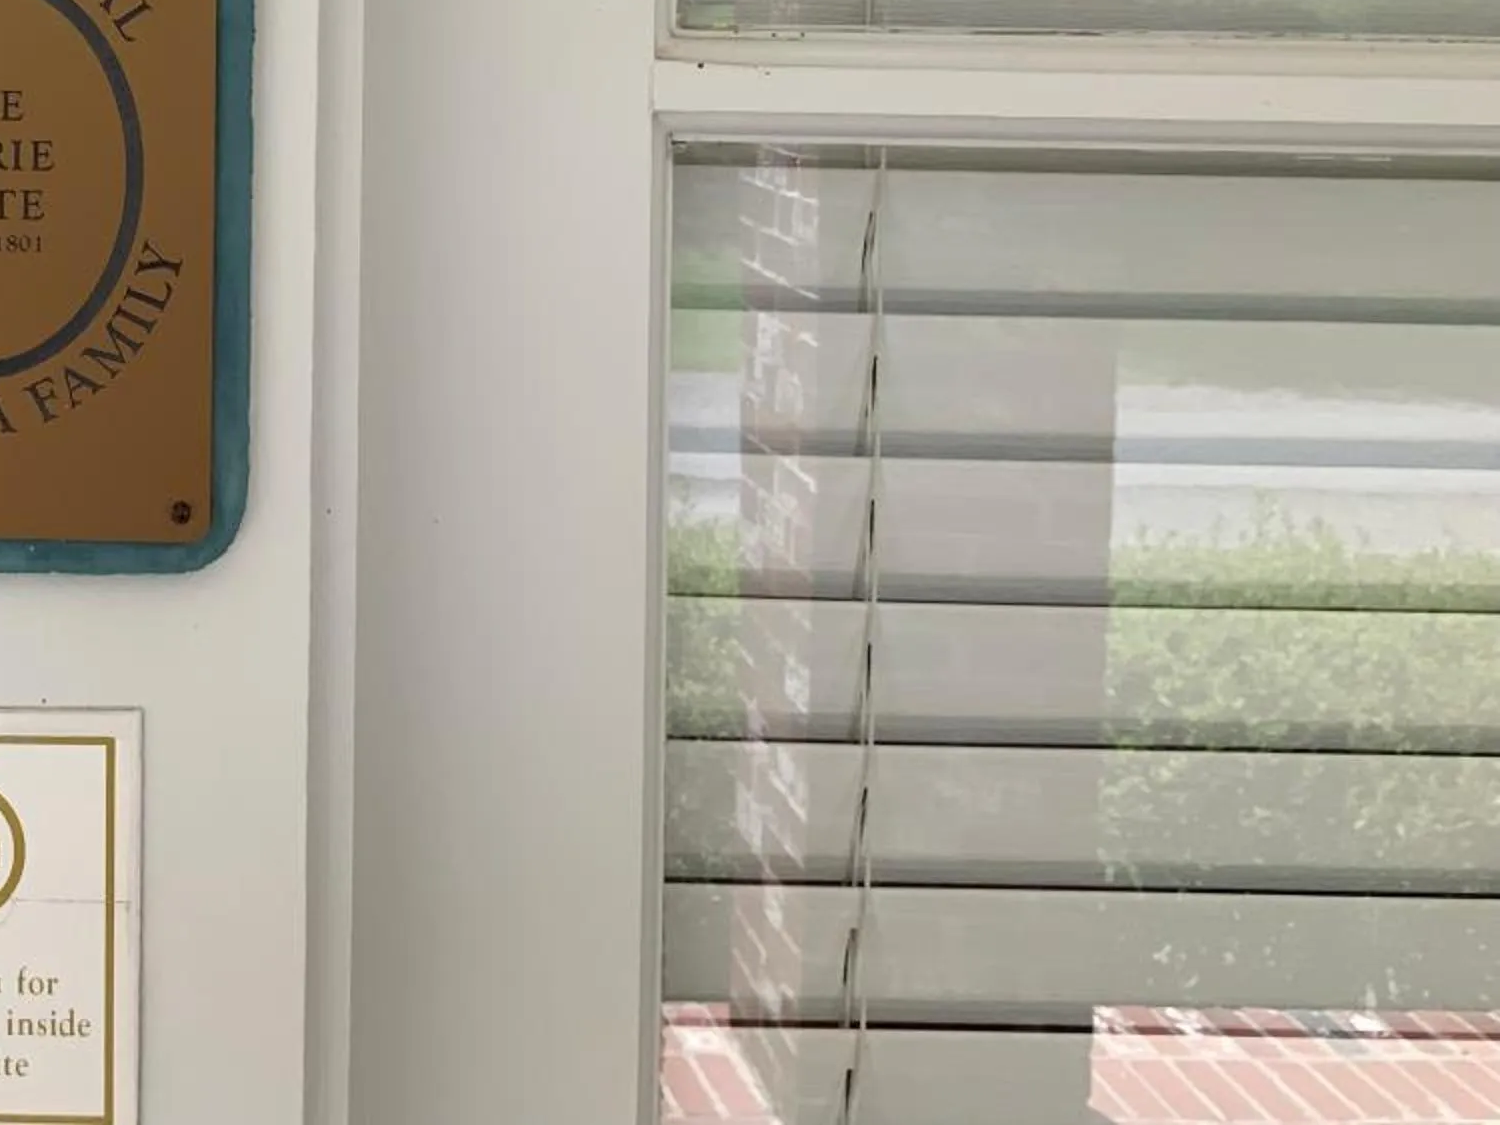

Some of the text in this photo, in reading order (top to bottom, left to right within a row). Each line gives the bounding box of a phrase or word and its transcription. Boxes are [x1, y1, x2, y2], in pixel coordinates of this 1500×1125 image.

[22, 239, 184, 424] FAMILY
[17, 965, 59, 995] for
[7, 1009, 91, 1038] inside
